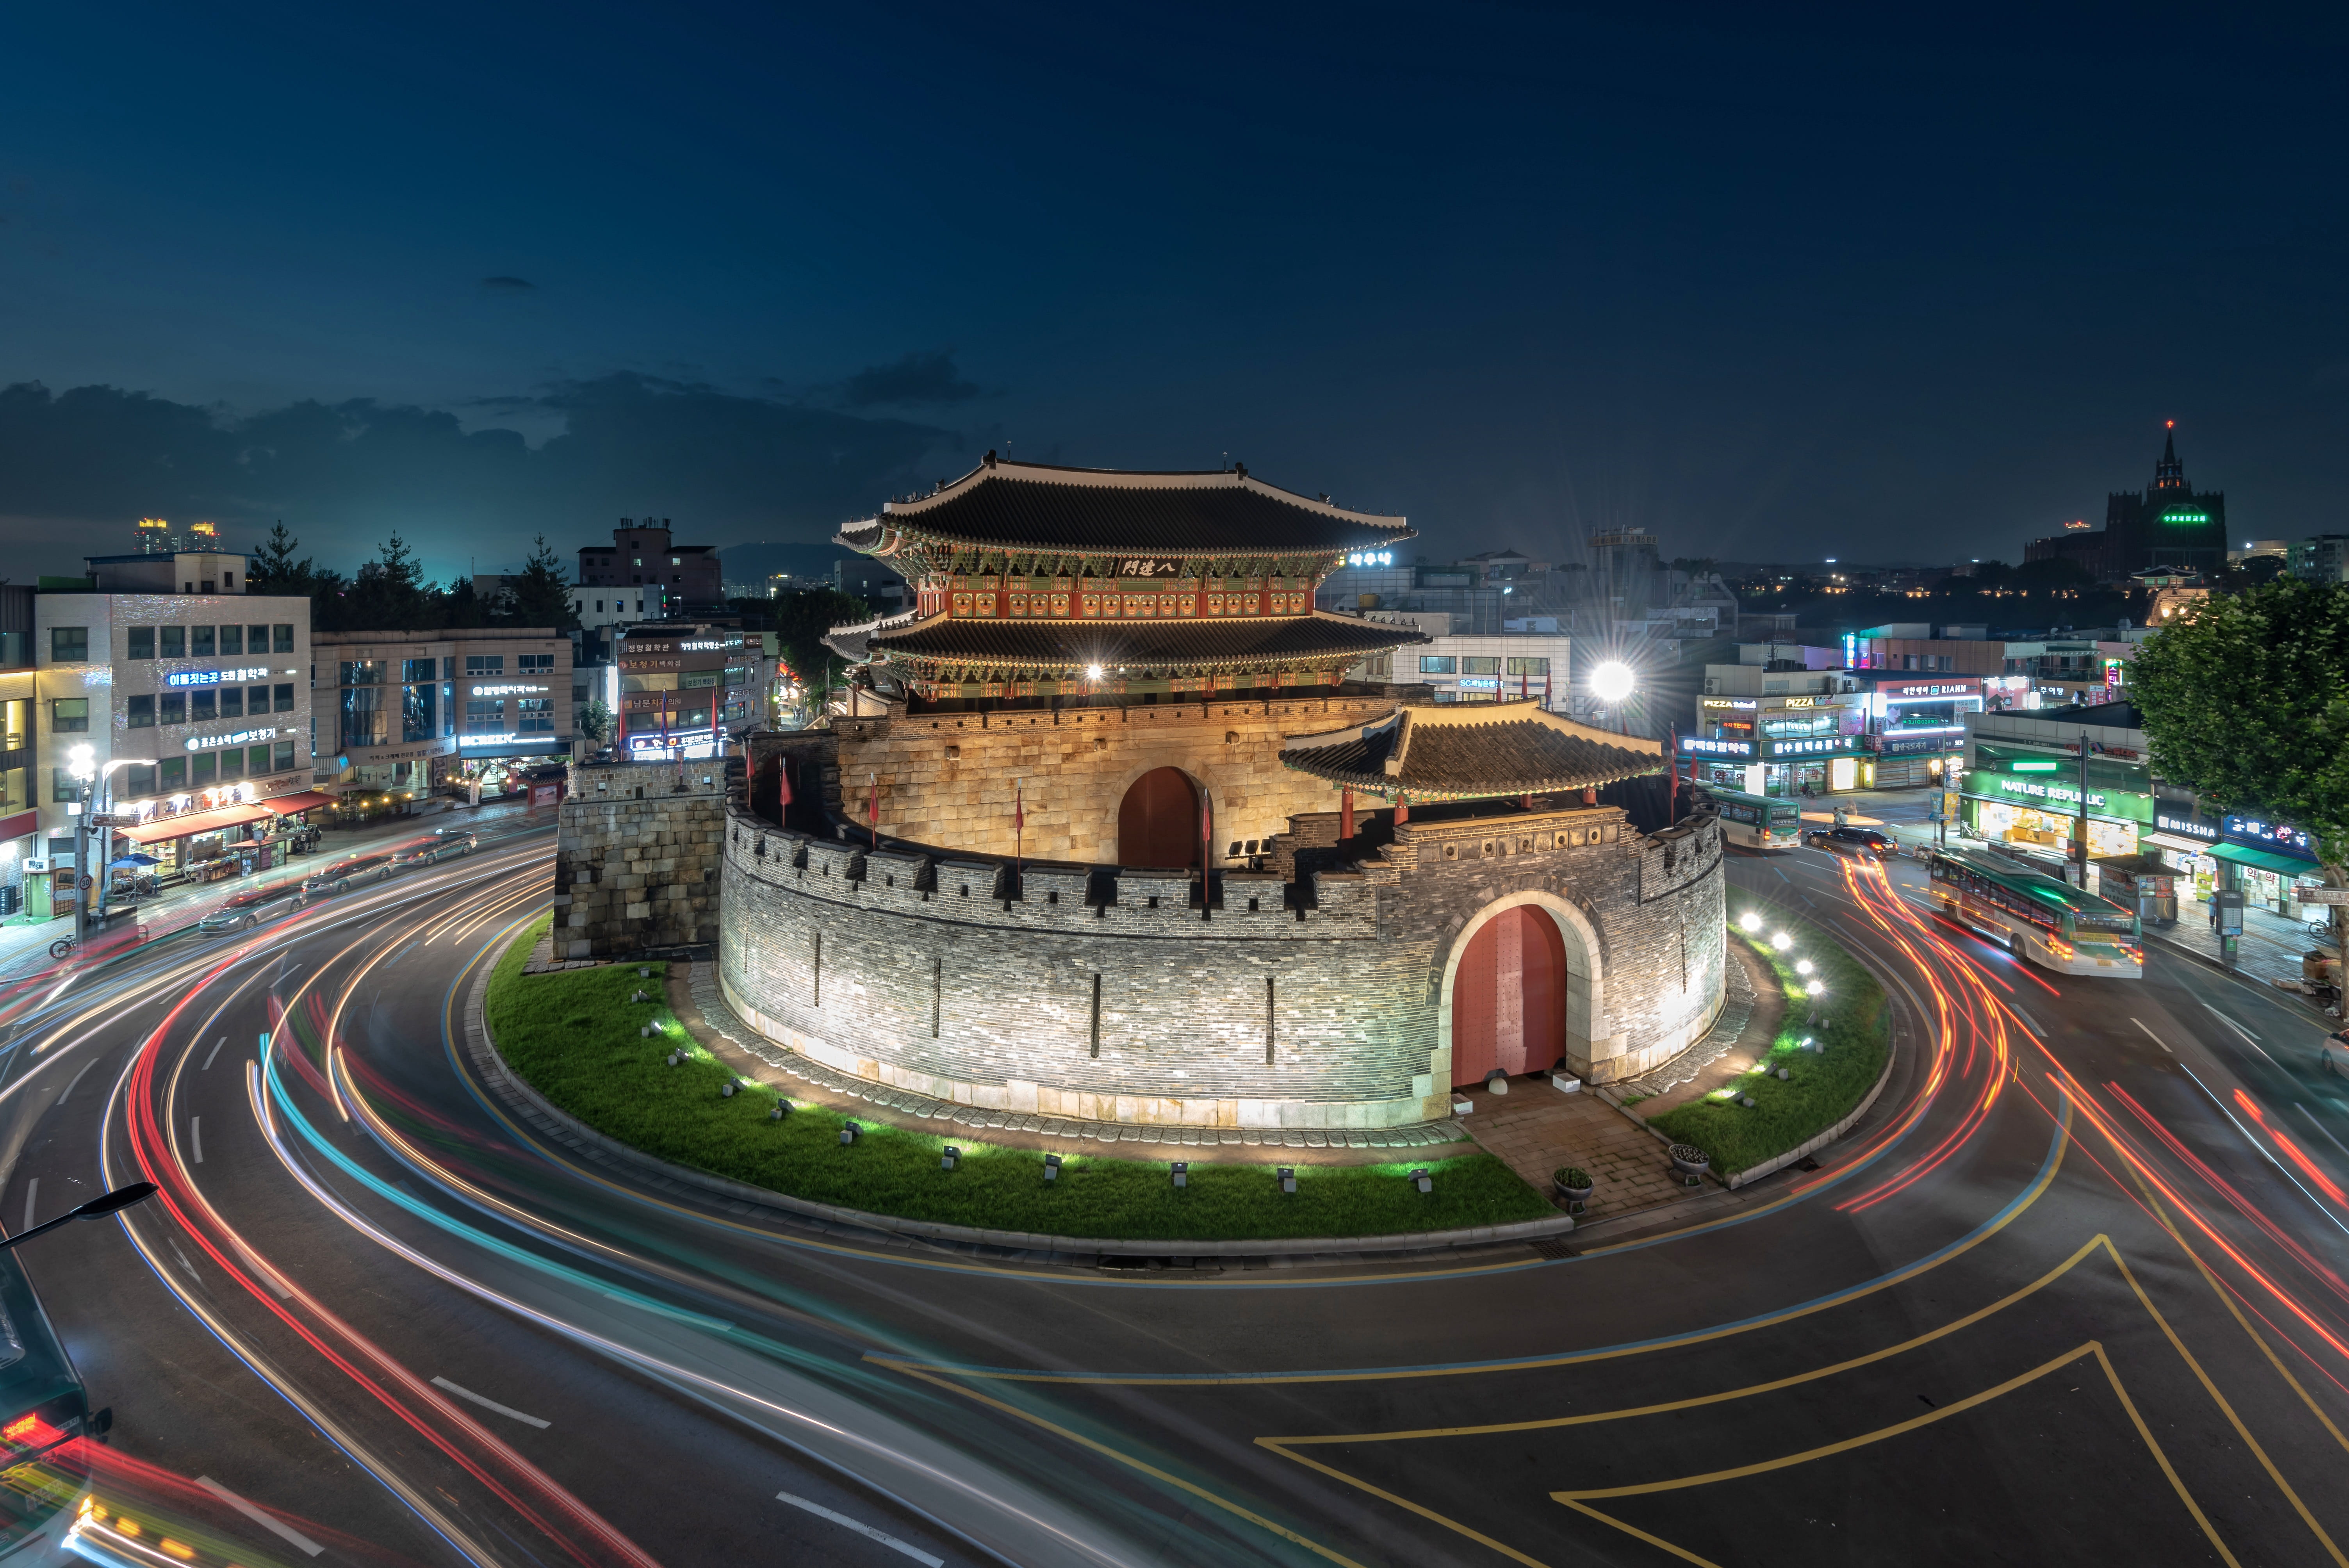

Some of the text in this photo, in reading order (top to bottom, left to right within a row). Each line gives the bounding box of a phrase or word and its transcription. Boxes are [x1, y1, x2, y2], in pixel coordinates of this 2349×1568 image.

[628, 643, 670, 652] 정명철학관
[629, 660, 658, 668] 보청기
[170, 672, 218, 686] 이름짓는곳
[1941, 684, 1966, 693] RIAHN
[2040, 686, 2064, 695] 추어탕
[1786, 698, 1814, 707] PIZZA
[248, 728, 275, 741] 보청기
[1864, 736, 1874, 749] 약
[1875, 737, 1882, 749] 약
[1715, 771, 1726, 782] 약
[1811, 769, 1819, 780] 약
[2001, 780, 2045, 796] NATURE
[2170, 820, 2215, 837] MISSHA
[2247, 868, 2257, 880] 약
[2265, 872, 2275, 884] 약
[1953, 888, 1958, 899] 13
